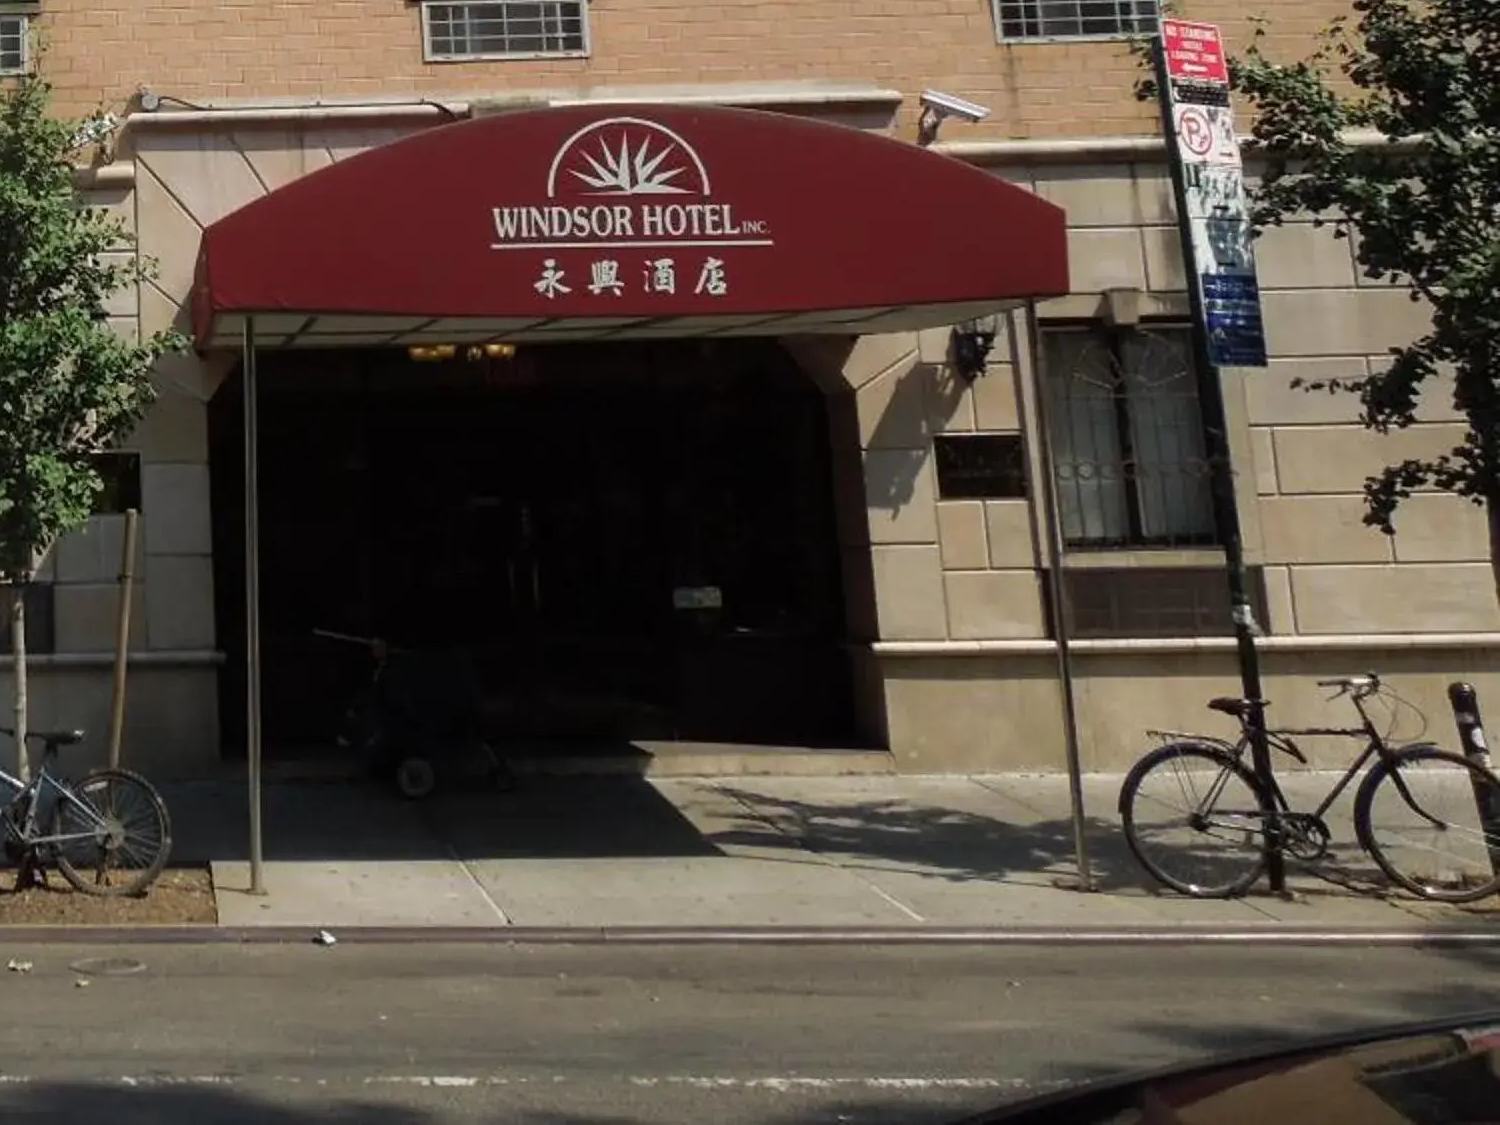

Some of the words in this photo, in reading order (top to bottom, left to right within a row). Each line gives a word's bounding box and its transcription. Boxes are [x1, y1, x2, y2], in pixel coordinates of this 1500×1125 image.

[492, 205, 633, 239] WINDSOR
[642, 204, 740, 236] HOTEL
[534, 256, 727, 298] 永興酒店
